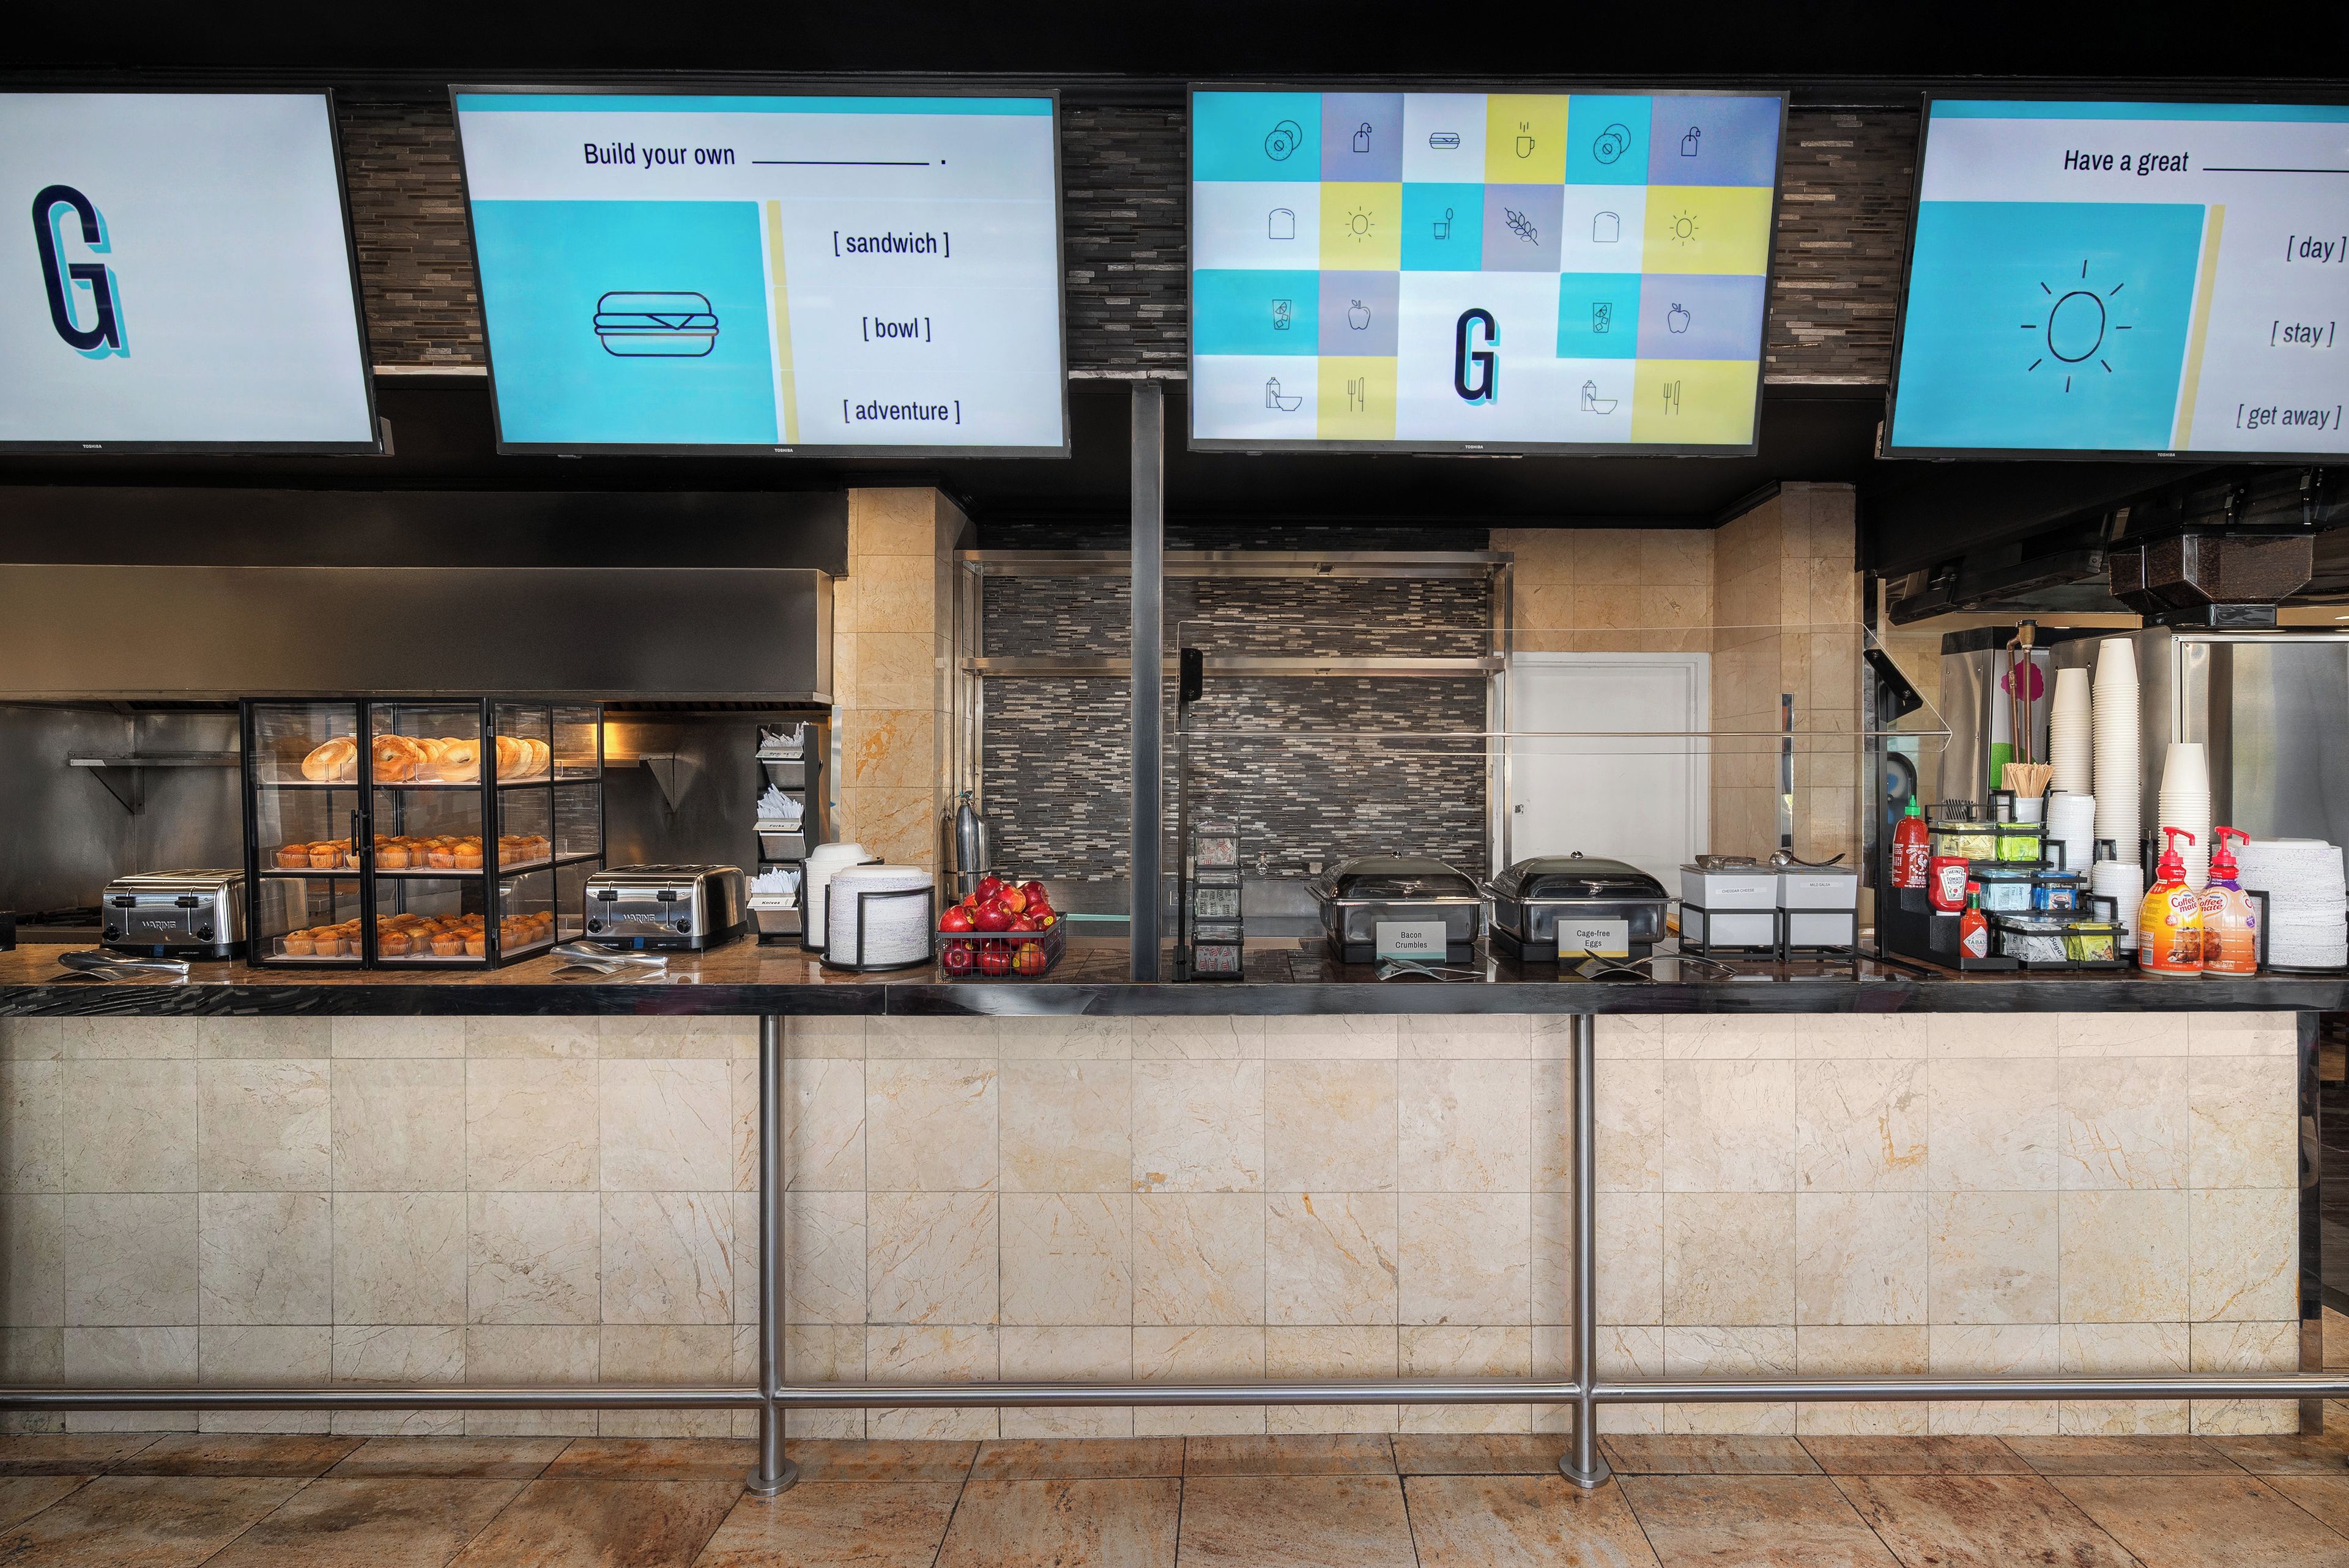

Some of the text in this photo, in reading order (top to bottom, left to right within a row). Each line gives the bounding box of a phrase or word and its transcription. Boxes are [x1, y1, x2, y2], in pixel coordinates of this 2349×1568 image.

[584, 142, 636, 165] Build
[642, 147, 687, 169] your
[694, 148, 735, 165] own
[2064, 149, 2189, 176] Have a great
[32, 185, 130, 360] G
[1455, 308, 1499, 406] G
[2171, 897, 2195, 907] Coffee
[2180, 902, 2197, 912] mate
[2198, 898, 2223, 907] offee
[623, 914, 655, 924] WARING
[141, 921, 176, 931] WARING
[1576, 929, 1610, 938] Cage-free
[2050, 937, 2064, 956] Sugar
